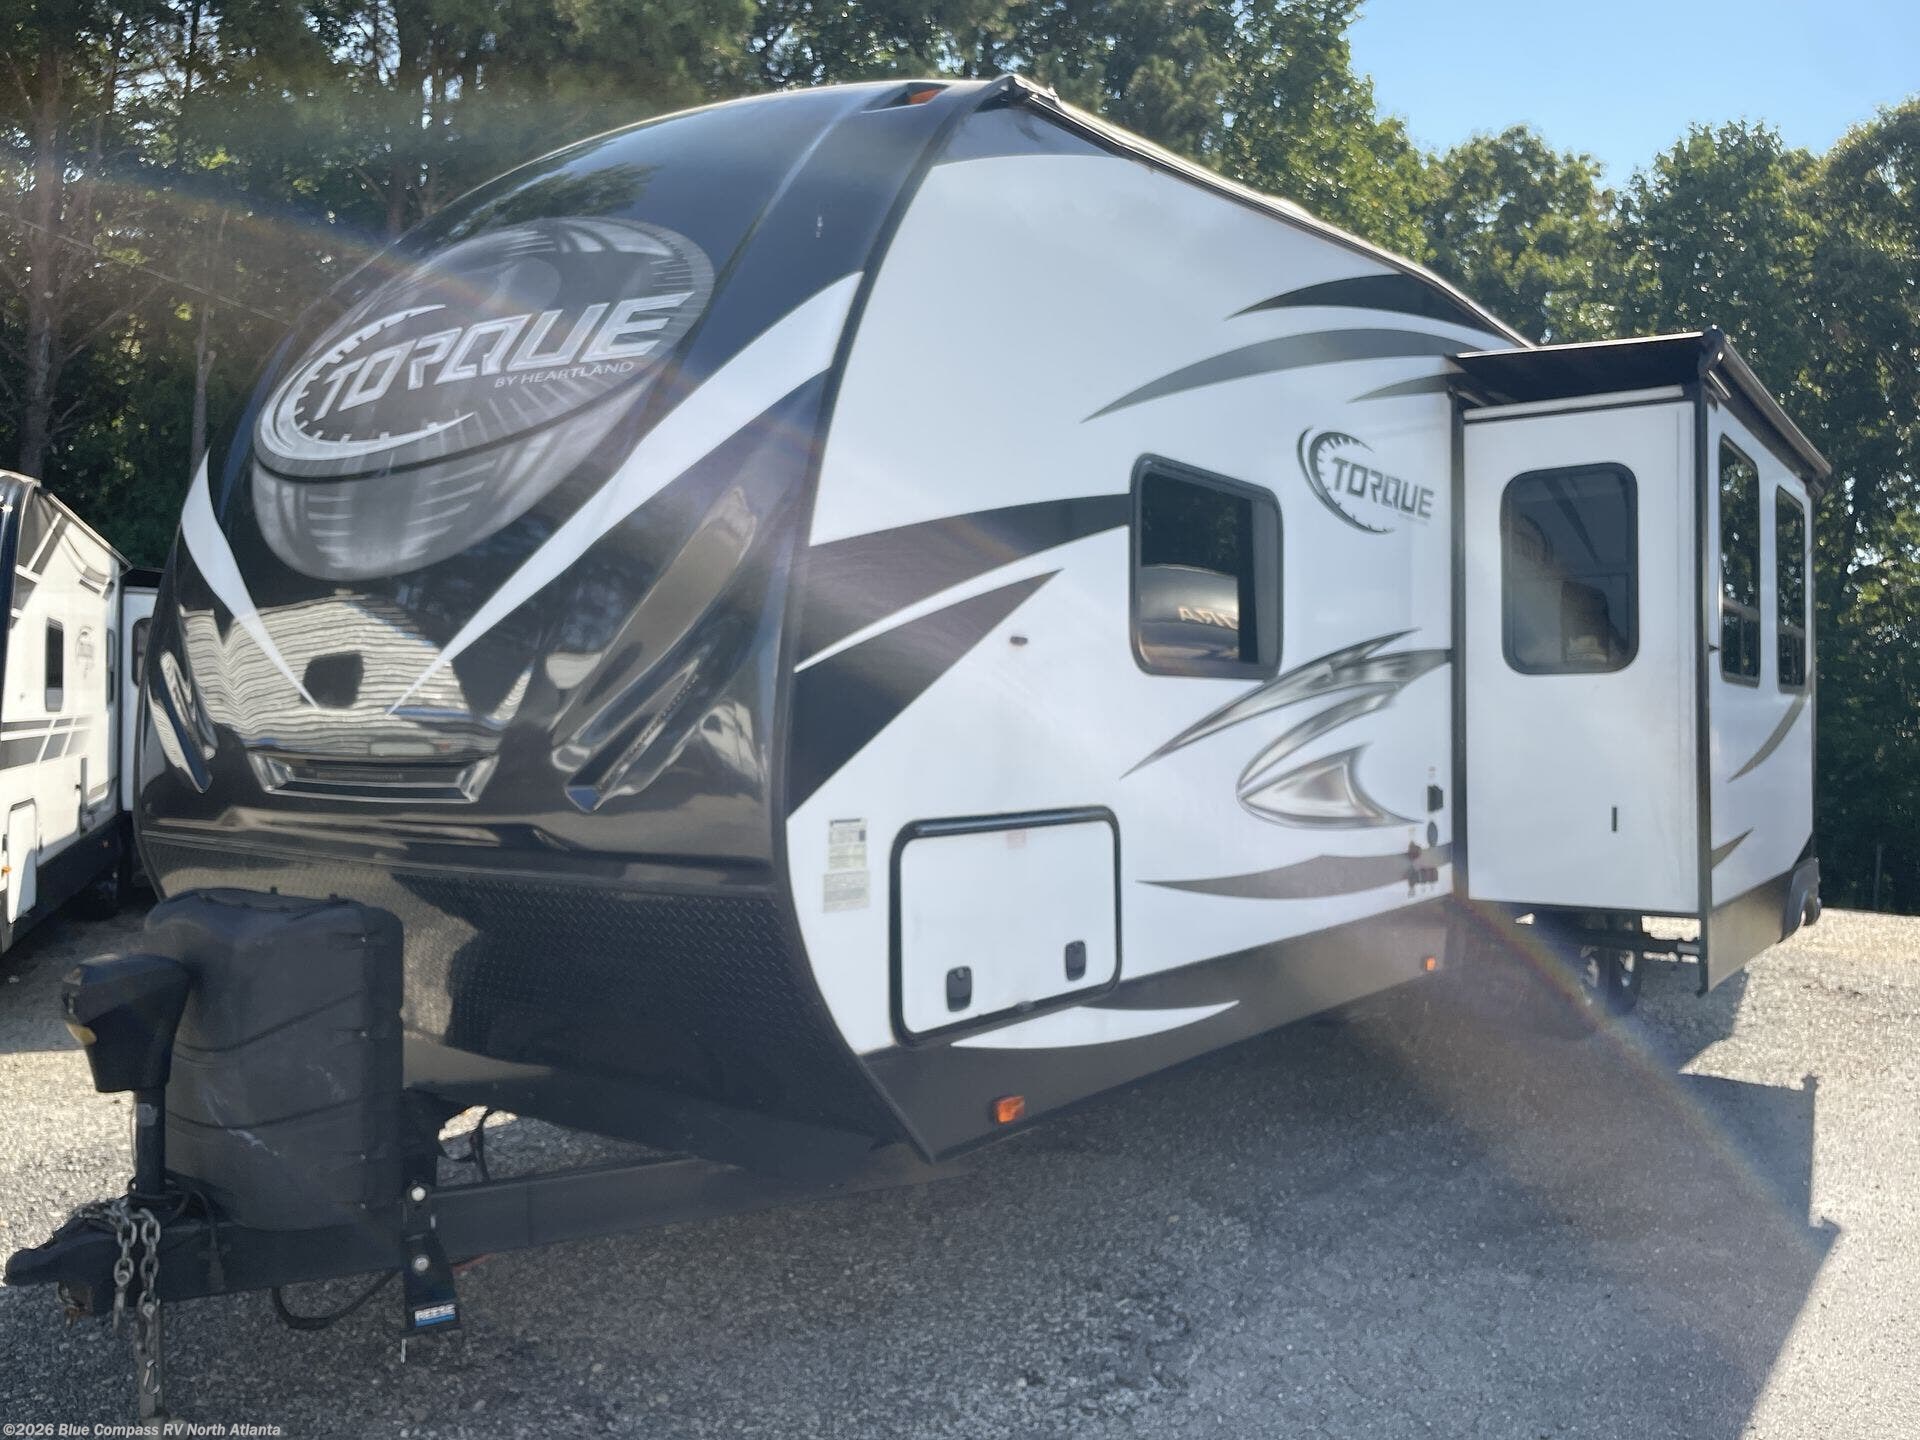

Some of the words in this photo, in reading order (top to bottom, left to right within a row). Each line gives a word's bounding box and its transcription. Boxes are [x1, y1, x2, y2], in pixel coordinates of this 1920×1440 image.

[313, 291, 695, 421] TORQUE
[494, 375, 518, 388] BY
[521, 361, 634, 384] HEARTLAND
[1332, 456, 1434, 518] TORQUE
